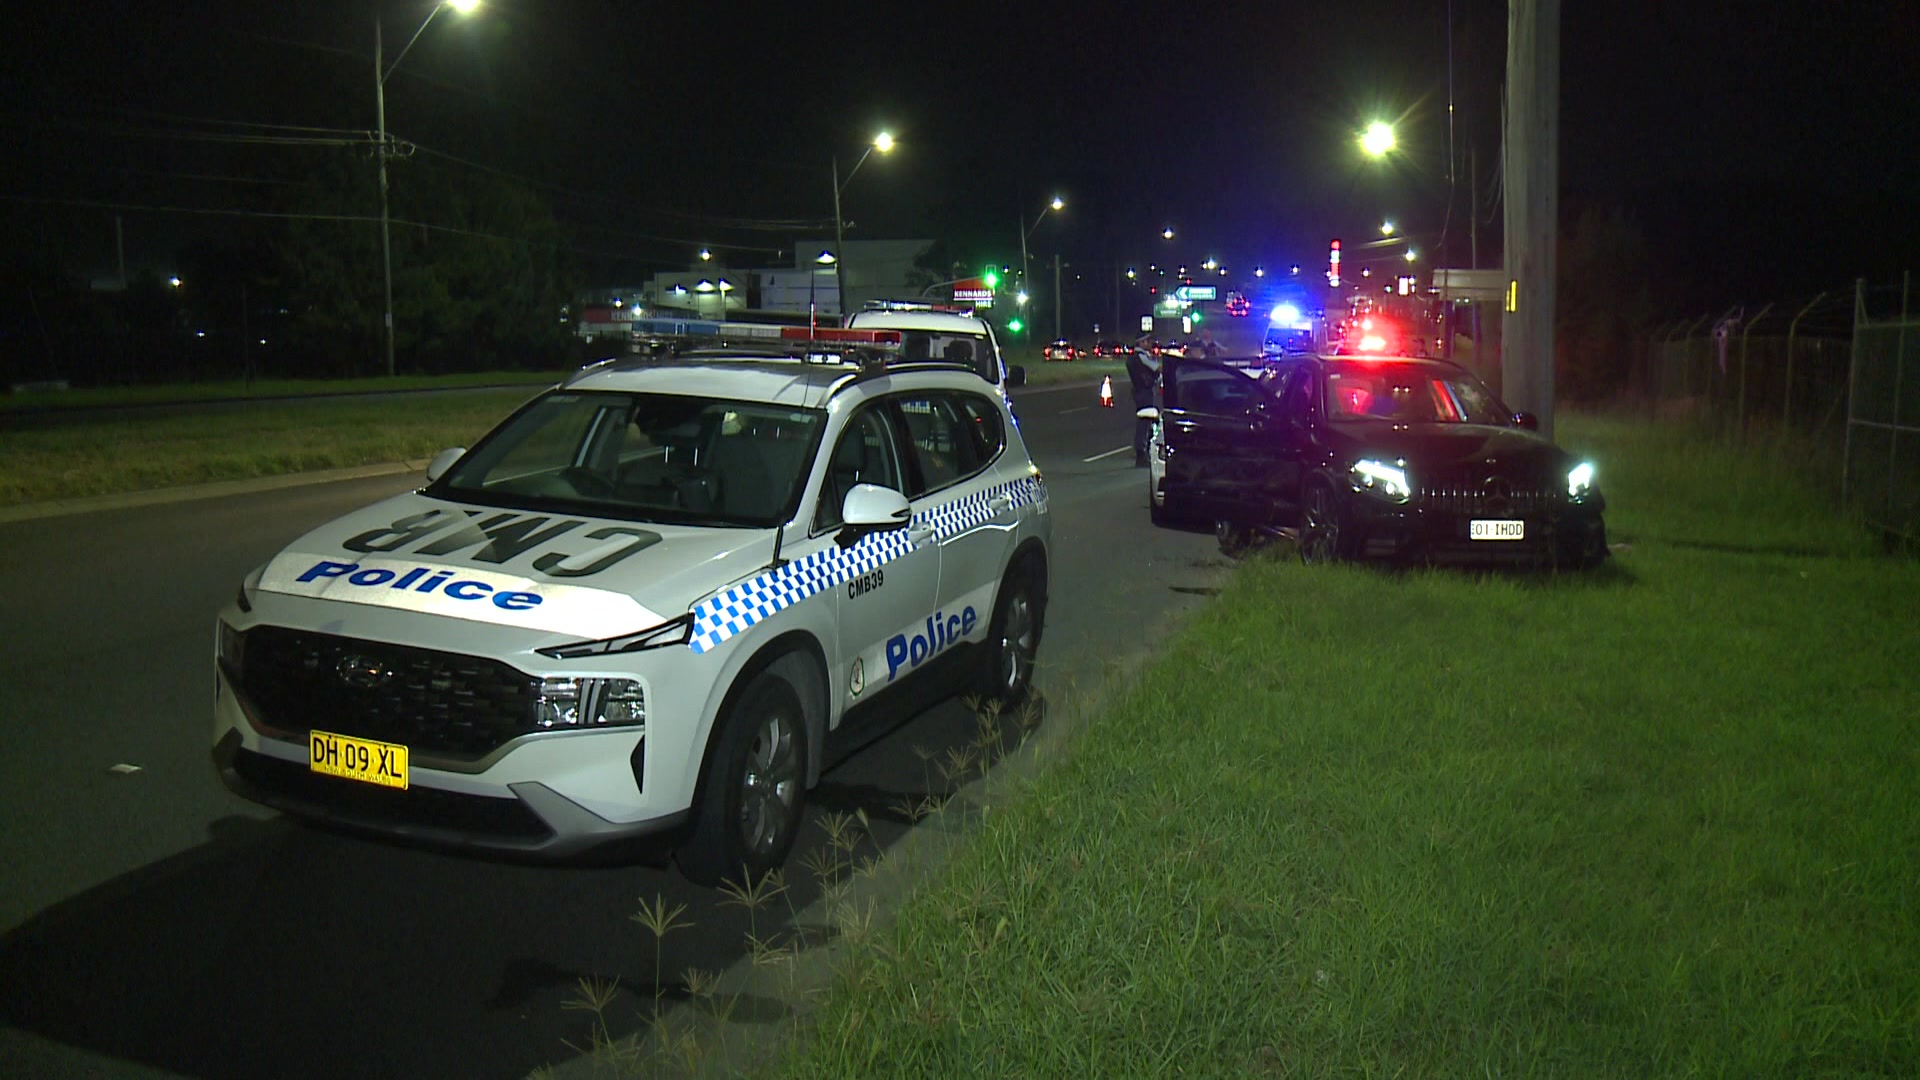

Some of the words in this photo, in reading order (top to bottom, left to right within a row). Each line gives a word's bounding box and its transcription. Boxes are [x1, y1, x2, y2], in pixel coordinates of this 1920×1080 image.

[953, 290, 992, 298] KENNARDS
[975, 300, 992, 308] HIRE
[295, 561, 543, 611] Police
[848, 569, 884, 600] CMB39
[885, 605, 977, 682] Police
[313, 737, 338, 767] DH
[345, 743, 369, 772] 09
[378, 747, 403, 779] XL
